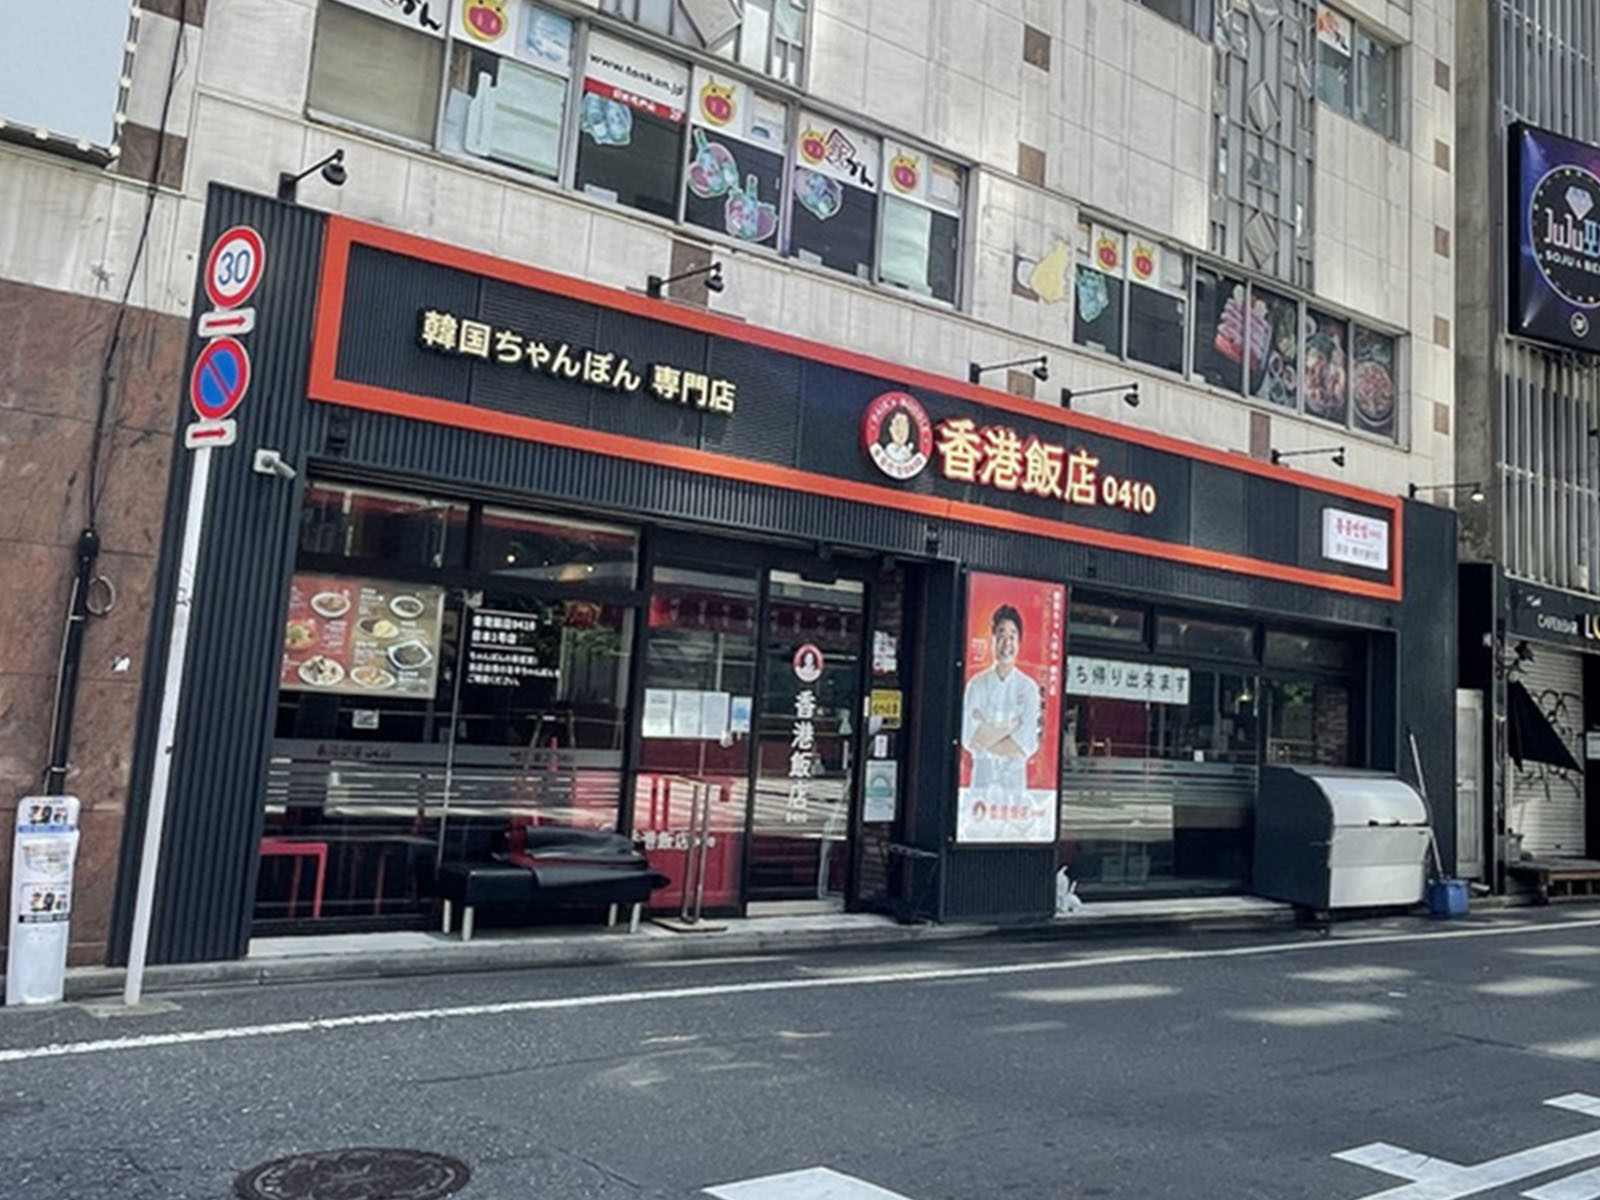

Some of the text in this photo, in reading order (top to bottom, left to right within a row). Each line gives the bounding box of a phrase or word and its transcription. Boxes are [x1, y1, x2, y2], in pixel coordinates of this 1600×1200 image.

[217, 249, 251, 286] 30
[421, 309, 737, 414] 韓国ちゃんぽん 専門店
[936, 417, 1099, 507] 香港飯店
[1101, 474, 1157, 514] 0410
[1066, 664, 1188, 694] ち帰り出来ます
[788, 690, 817, 809] 香港飯店
